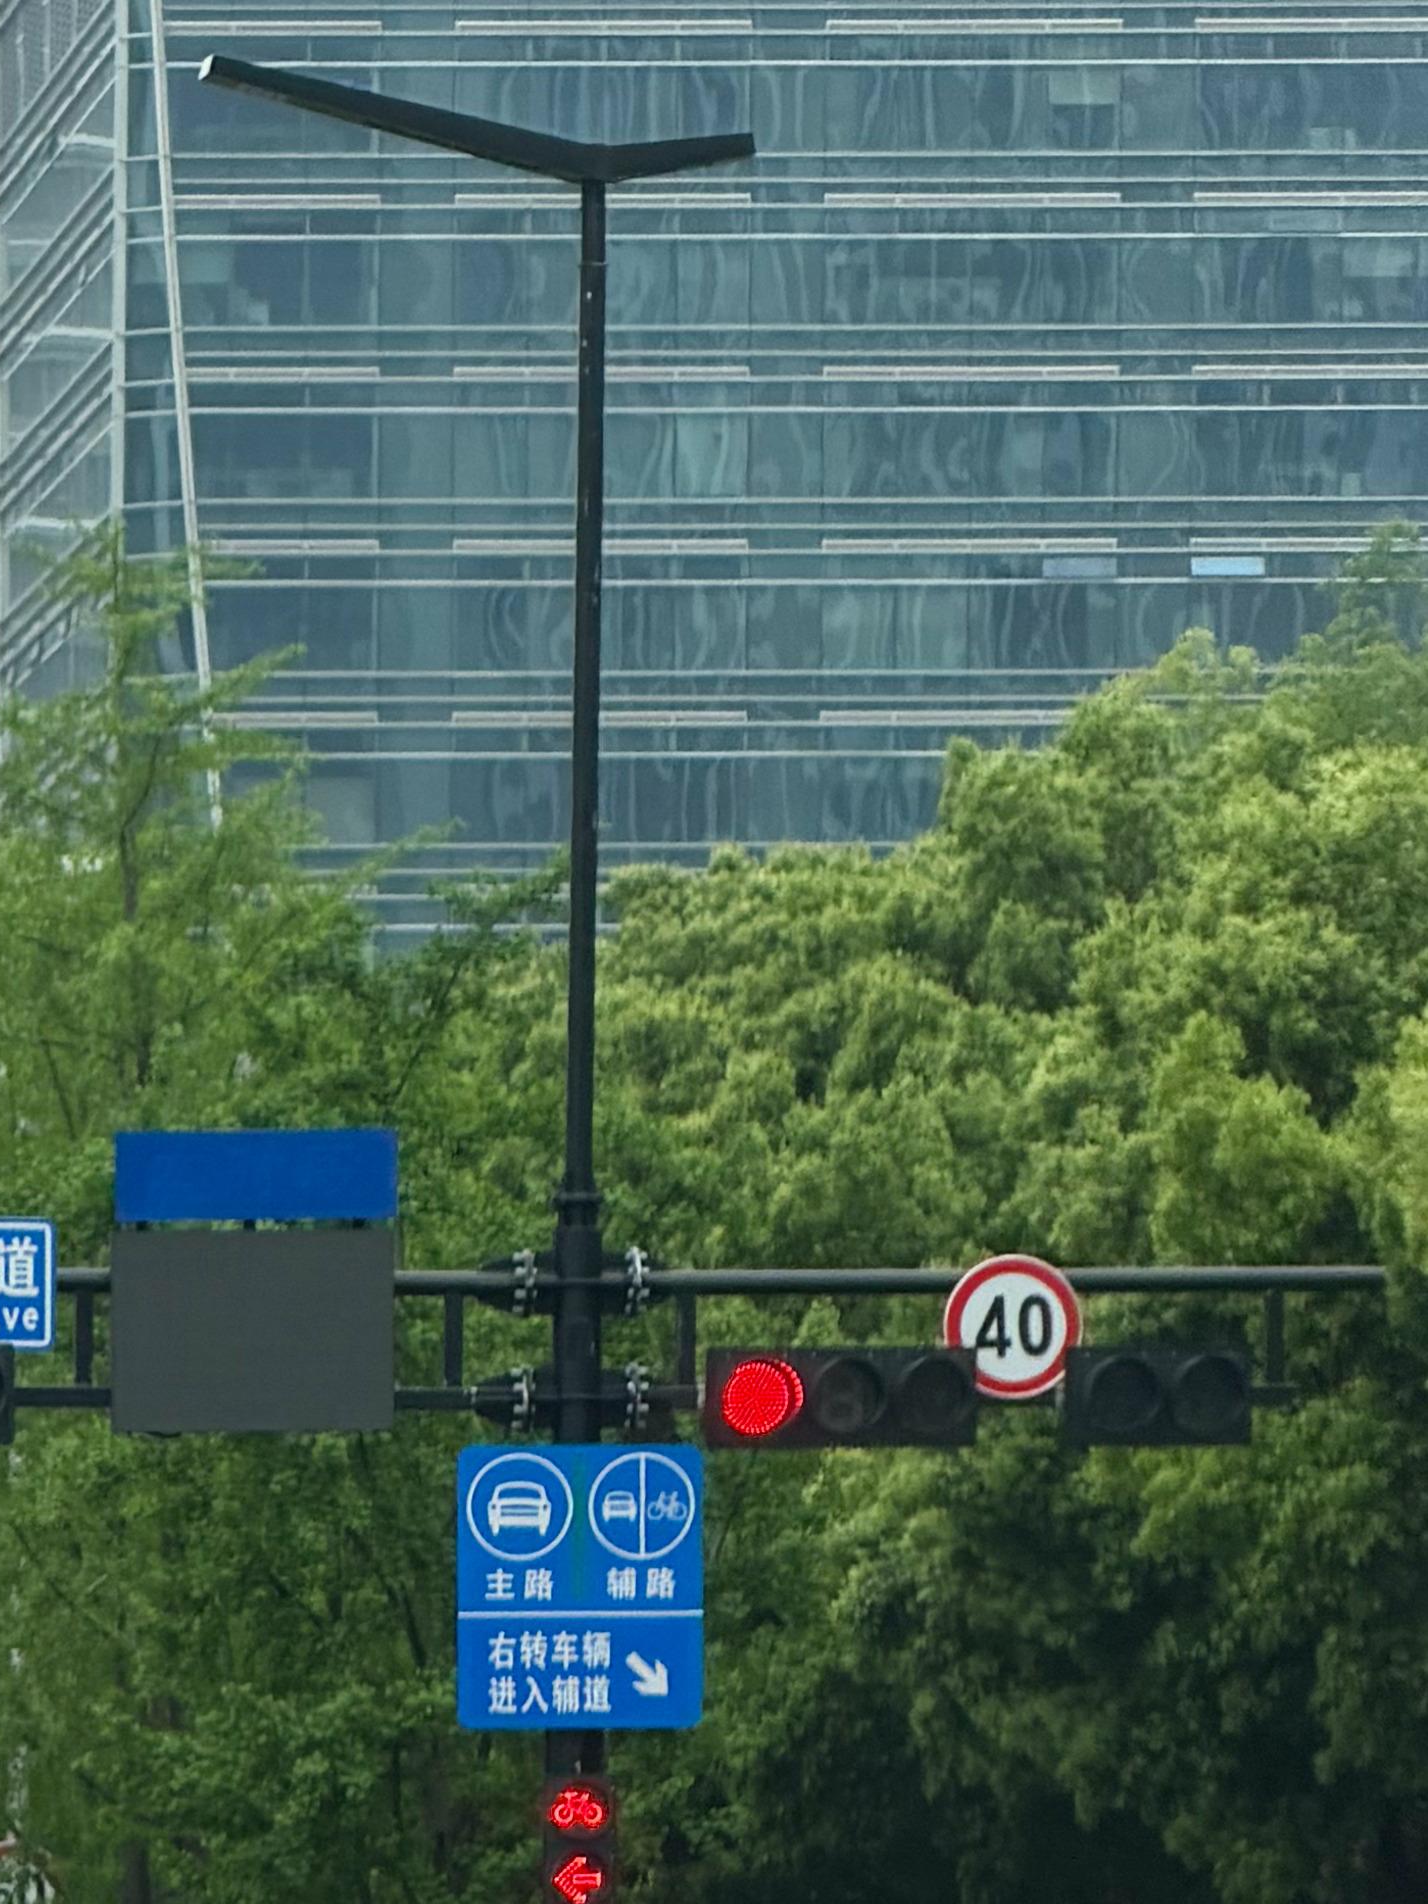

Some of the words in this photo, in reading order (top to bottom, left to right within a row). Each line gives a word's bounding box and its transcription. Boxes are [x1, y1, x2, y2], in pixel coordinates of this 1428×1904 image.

[976, 1293, 1053, 1359] 40
[484, 1567, 555, 1602] 主路
[605, 1566, 677, 1601] 辅路
[488, 1630, 611, 1671] 右转车辆
[488, 1674, 612, 1715] 进入辅道
